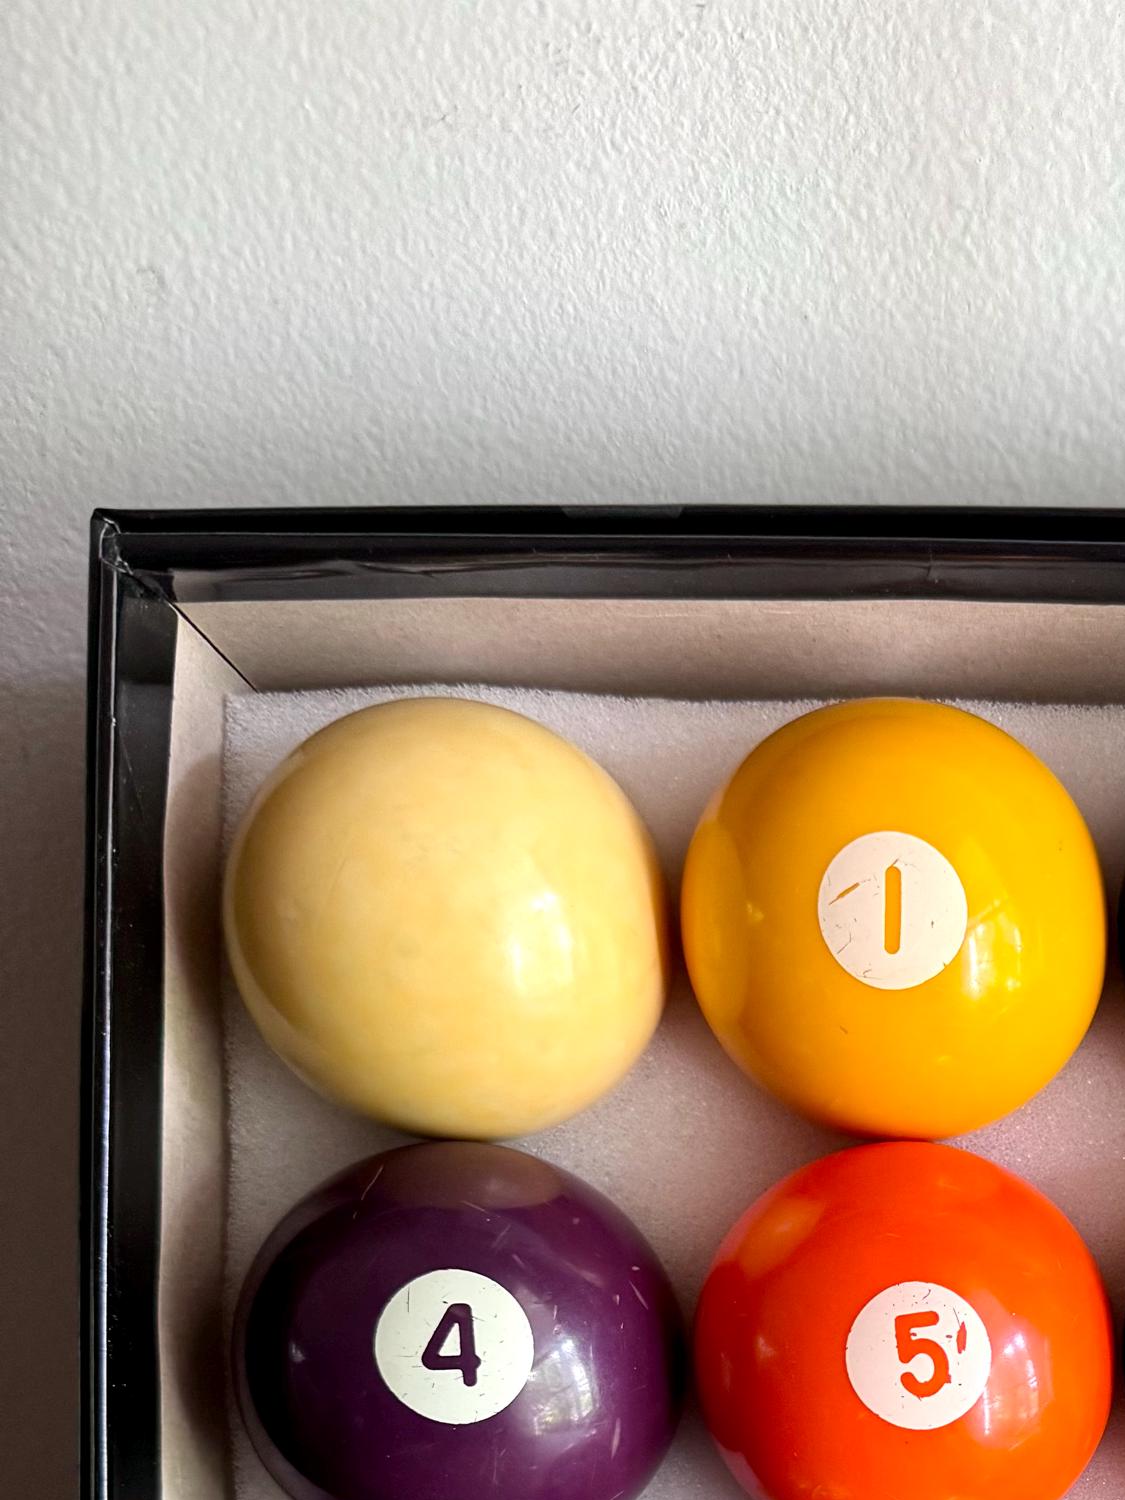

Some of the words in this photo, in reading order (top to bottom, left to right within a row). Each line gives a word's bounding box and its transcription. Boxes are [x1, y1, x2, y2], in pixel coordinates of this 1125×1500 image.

[884, 866, 901, 954] 1
[421, 1302, 482, 1387] 4
[894, 1310, 949, 1398] 5
